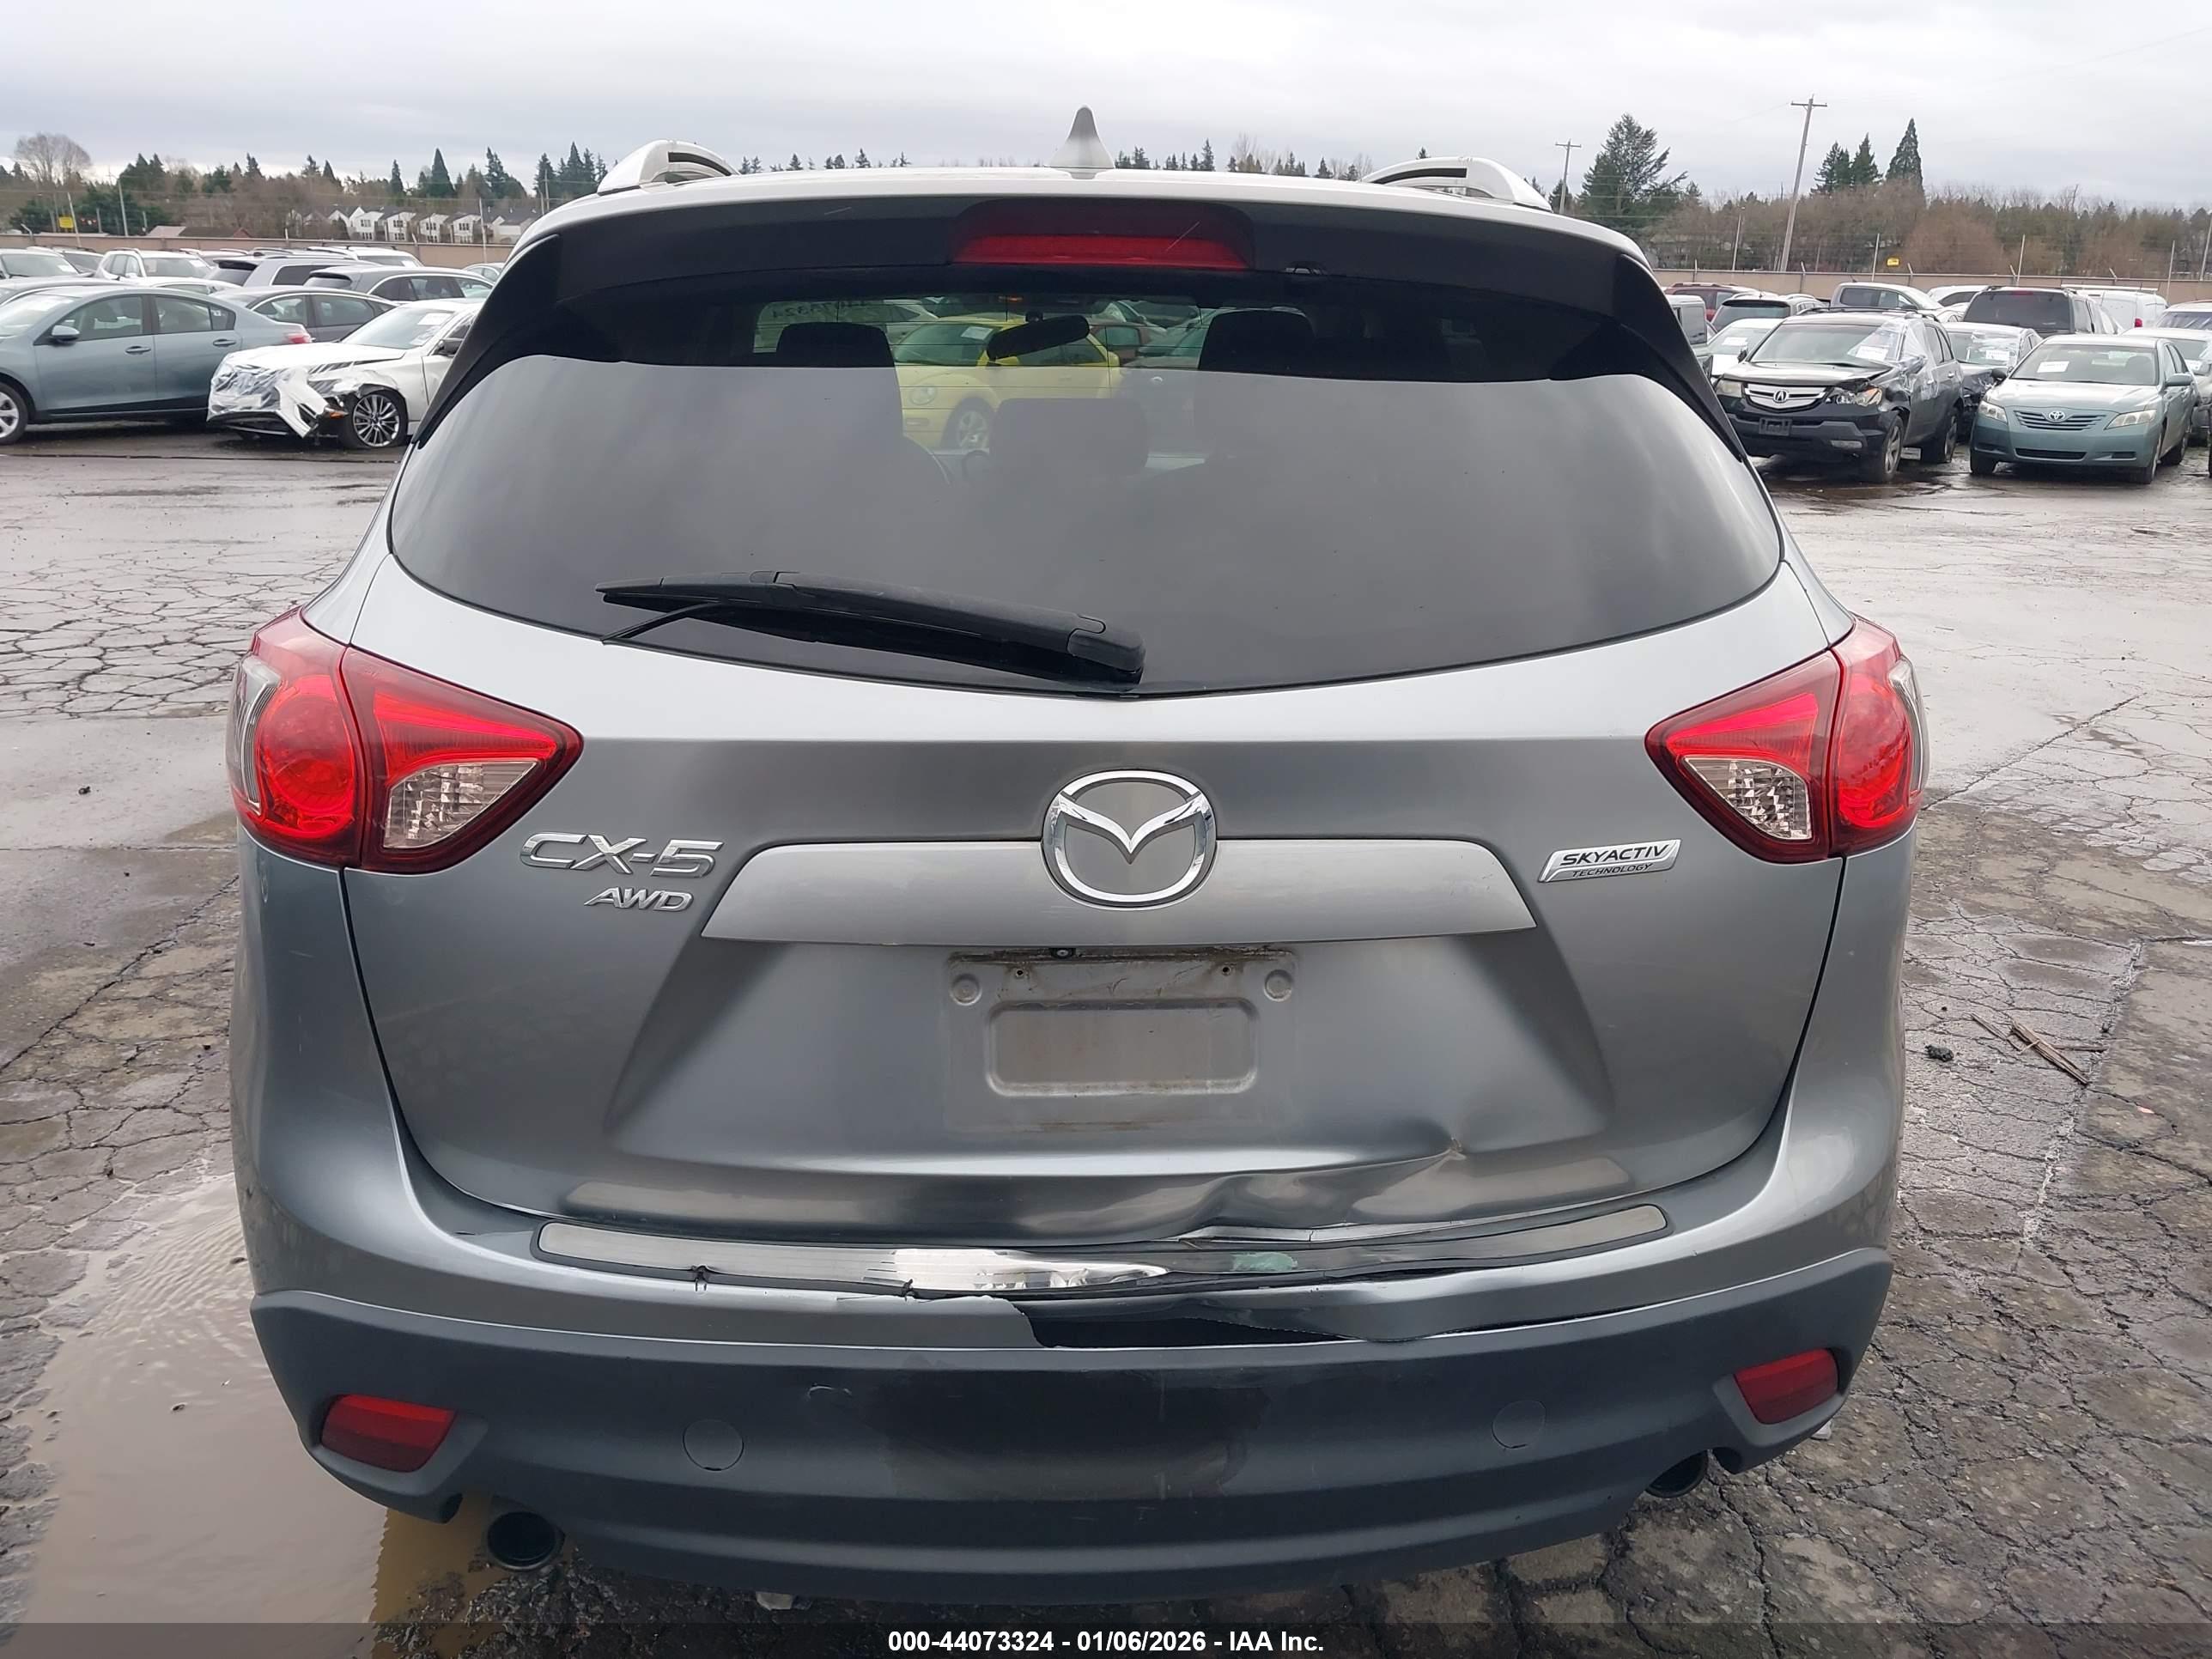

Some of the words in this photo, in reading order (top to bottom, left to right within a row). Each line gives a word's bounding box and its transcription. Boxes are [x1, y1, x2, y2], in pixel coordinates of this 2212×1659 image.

[520, 832, 724, 878] CX-5
[1559, 844, 1669, 866] SKYACTIV
[1572, 863, 1653, 877] TECHNOLOGY
[584, 886, 694, 912] AWD
